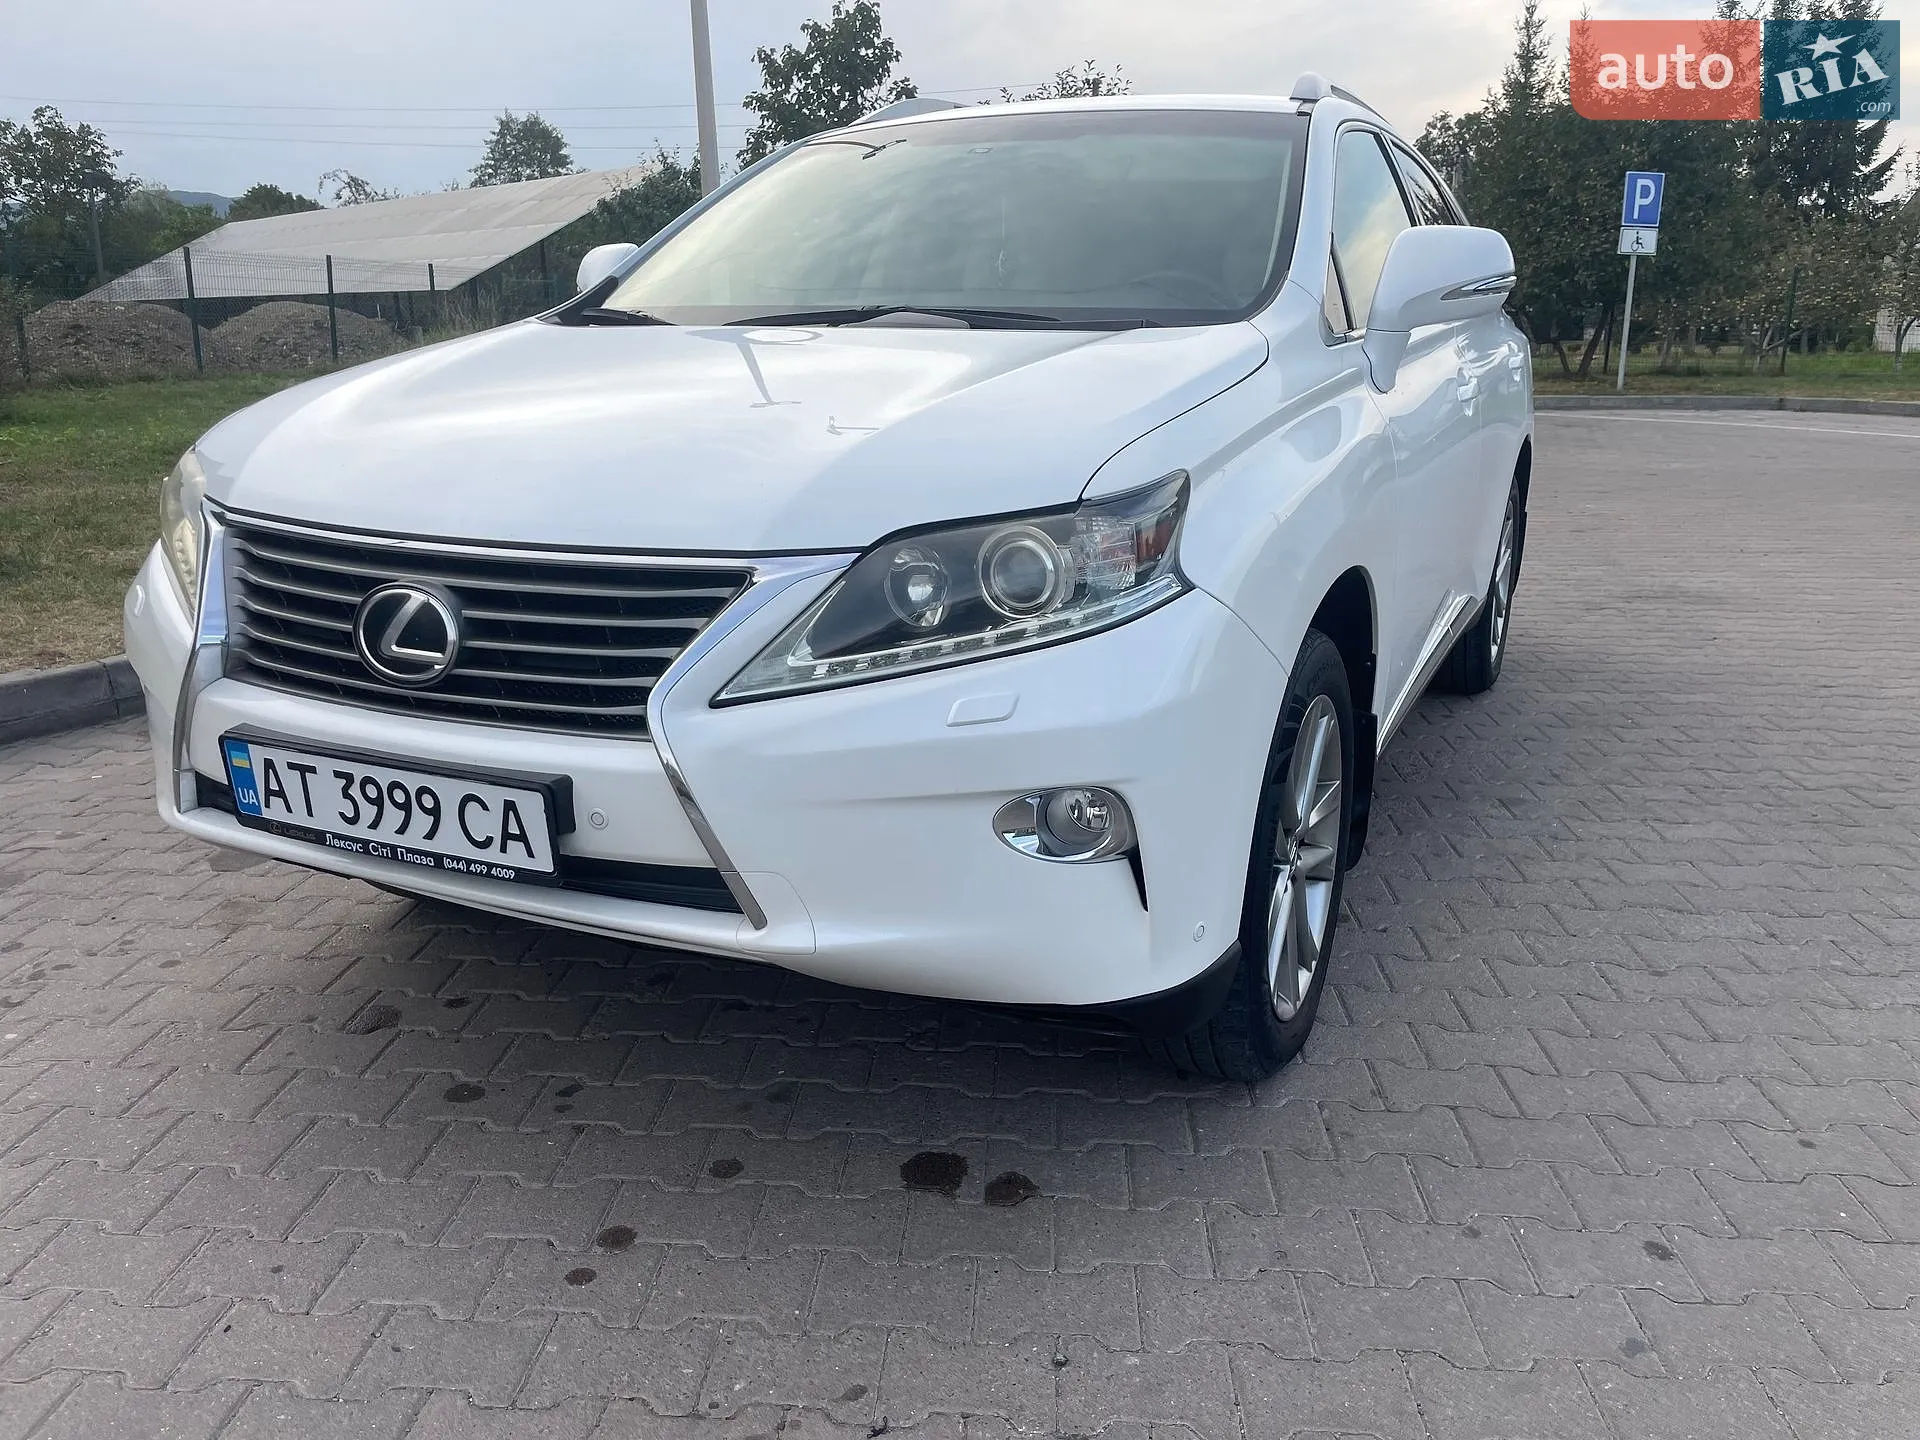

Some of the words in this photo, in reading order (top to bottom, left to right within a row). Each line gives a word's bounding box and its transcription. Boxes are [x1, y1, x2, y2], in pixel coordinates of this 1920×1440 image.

[1633, 178, 1656, 220] P
[238, 787, 259, 806] UA
[263, 757, 318, 818] AT
[333, 769, 442, 841] 3999
[458, 792, 536, 860] CA
[325, 833, 364, 853] Лексус
[368, 842, 392, 859] Сіті
[397, 848, 435, 867] Плаза
[443, 857, 467, 872] (044)
[469, 863, 488, 875] 499
[490, 868, 516, 880] 4009
